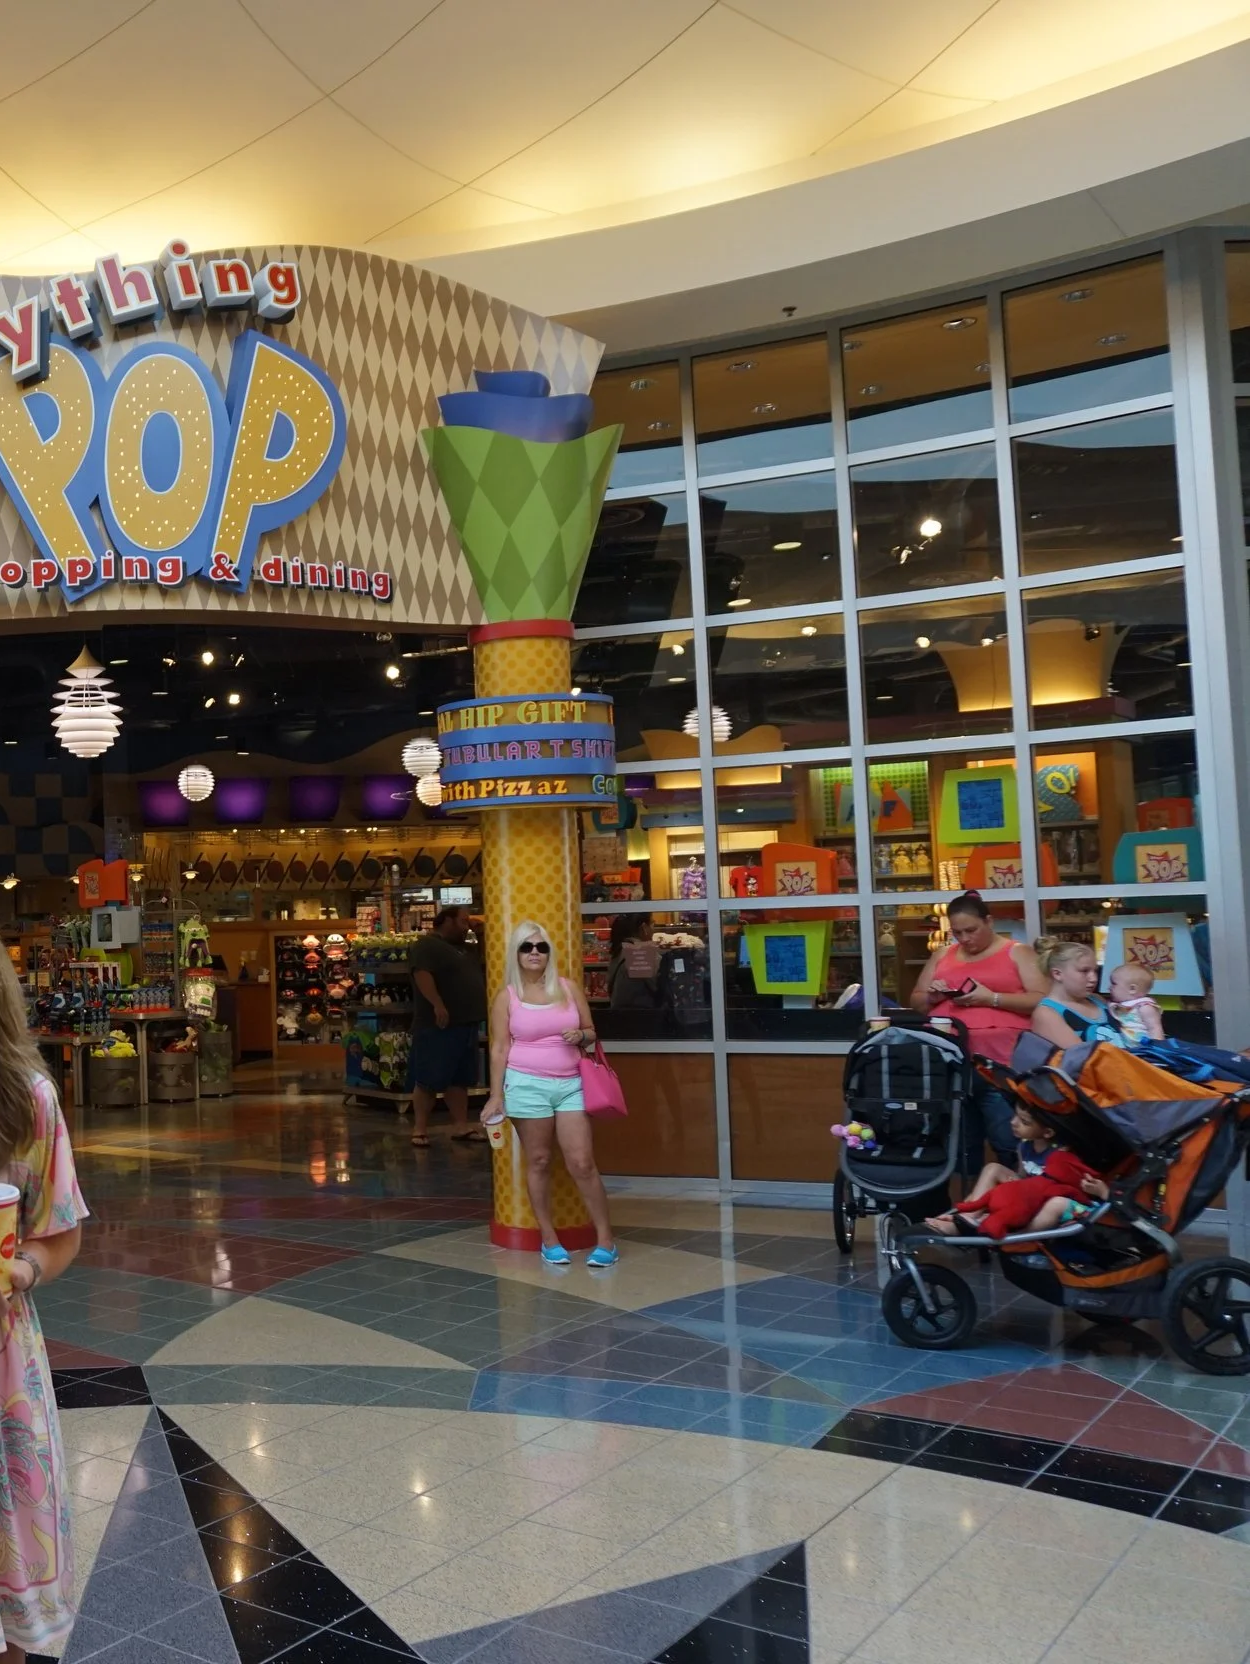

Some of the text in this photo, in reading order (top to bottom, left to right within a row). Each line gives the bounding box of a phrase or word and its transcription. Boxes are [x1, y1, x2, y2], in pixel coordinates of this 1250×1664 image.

[209, 552, 240, 582] &
[262, 555, 391, 599] dining
[459, 704, 504, 730] HIP
[516, 701, 586, 724] GIFT
[550, 740, 564, 758] T
